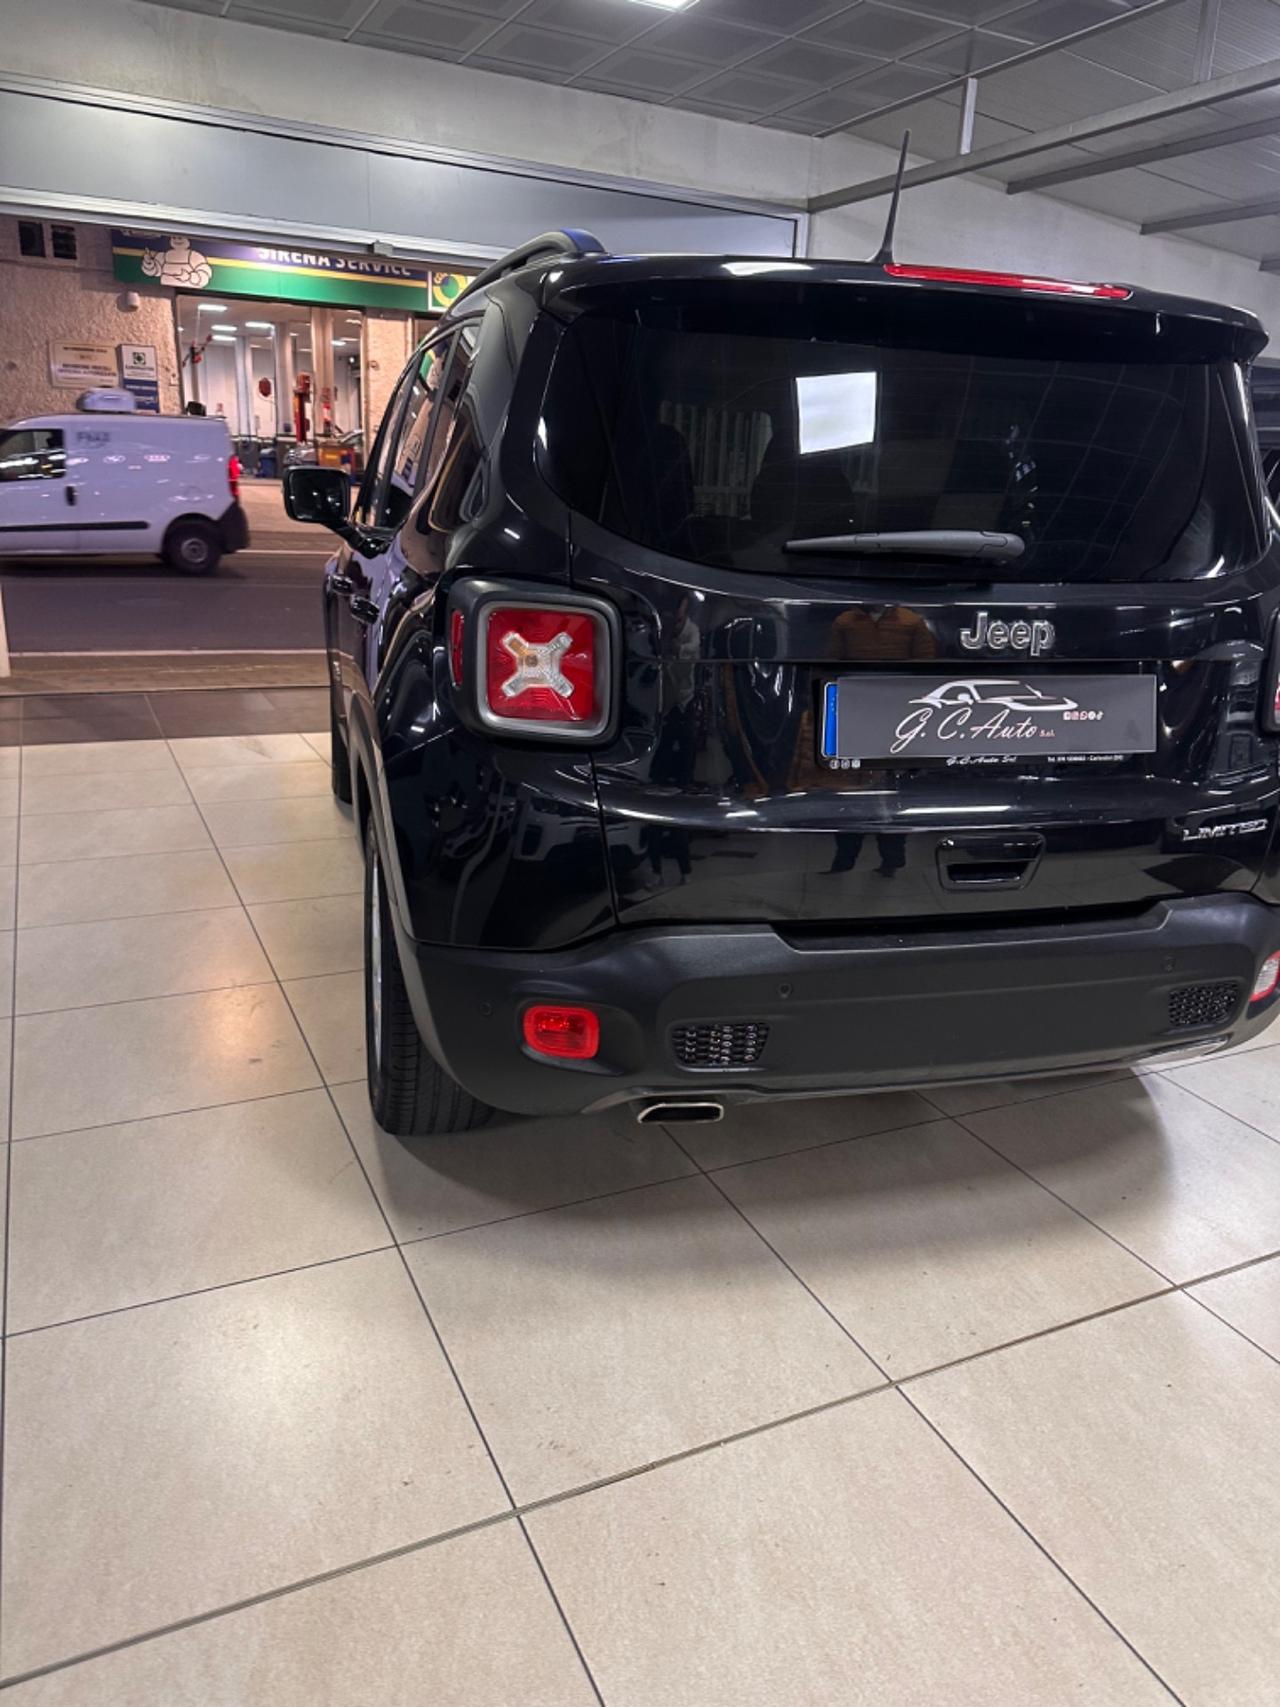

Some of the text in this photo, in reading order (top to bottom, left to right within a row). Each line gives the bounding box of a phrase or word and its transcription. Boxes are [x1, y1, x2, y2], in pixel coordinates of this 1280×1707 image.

[258, 249, 330, 267] SIRENA
[960, 611, 1055, 656] Jeep
[1183, 819, 1268, 841] LIMITED
